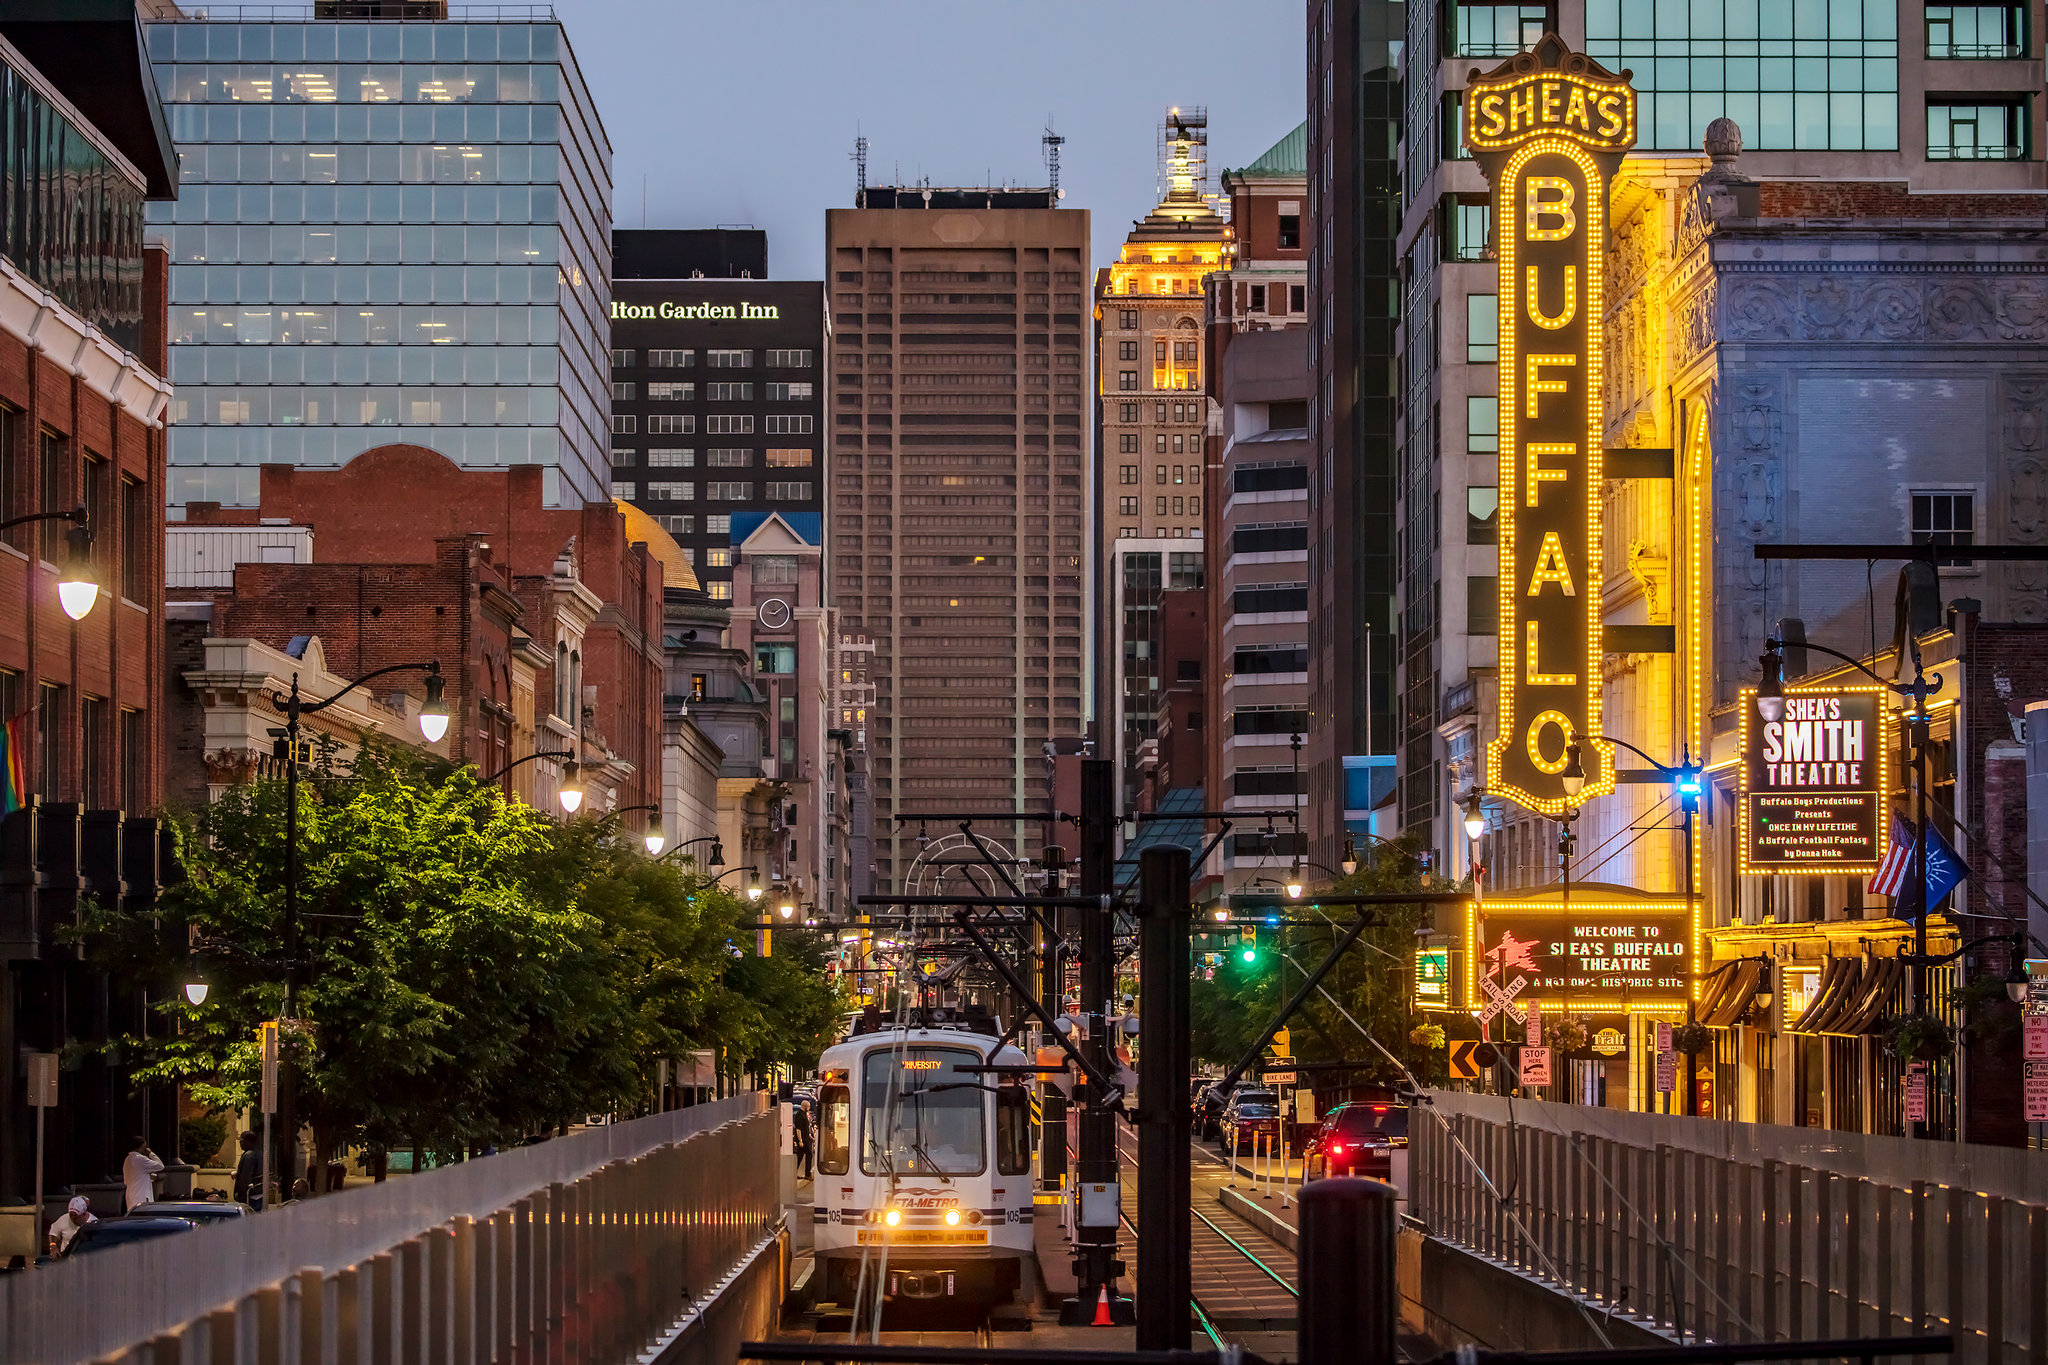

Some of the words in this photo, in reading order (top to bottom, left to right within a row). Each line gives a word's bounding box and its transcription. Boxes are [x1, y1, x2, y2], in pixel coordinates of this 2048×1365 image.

[1480, 82, 1623, 137] SHEA'S
[659, 302, 737, 319] Garden
[741, 302, 779, 319] Inn
[1526, 176, 1577, 775] BUFFALO
[1785, 698, 1841, 721] SHEA'S
[1763, 720, 1863, 763] SMITH
[1767, 763, 1861, 786] THEATRE
[1760, 798, 1792, 806] Buffalo
[1794, 798, 1812, 807] Boys
[1814, 797, 1863, 806] Productions
[1768, 823, 1790, 831] ONCE
[1792, 823, 1801, 831] IN
[1803, 823, 1815, 831] MY
[1816, 823, 1857, 831] LIFETIME
[1759, 837, 1765, 845] A
[1766, 837, 1798, 845] Buffalo
[1800, 836, 1832, 844] Football
[1834, 836, 1867, 845] Fantasy
[1785, 850, 1794, 858] by
[1796, 849, 1820, 857] Donna
[1822, 849, 1842, 857] Hoke
[1574, 926, 1636, 937] WELCOME
[1642, 926, 1659, 937] TO
[1614, 942, 1684, 956] BUFFALO
[1580, 957, 1651, 971] THEATRE
[1533, 978, 1541, 987] A
[1545, 978, 1598, 987] NATONAL
[1658, 978, 1684, 987] SITE
[1480, 977, 1497, 998] RAIL
[1505, 1002, 1525, 1024] ROAD
[1481, 978, 1524, 1021] CROSSING
[2031, 1018, 2041, 1026] NO
[1592, 1033, 1626, 1045] Tralf
[1525, 1050, 1546, 1058] STOP
[2026, 1065, 2032, 1077] 2
[1908, 1076, 1913, 1086] 2
[884, 1197, 958, 1208] FTA-METRO
[828, 1210, 841, 1222] 105
[1006, 1210, 1019, 1222] 105
[966, 1233, 985, 1241] FOLLOW
